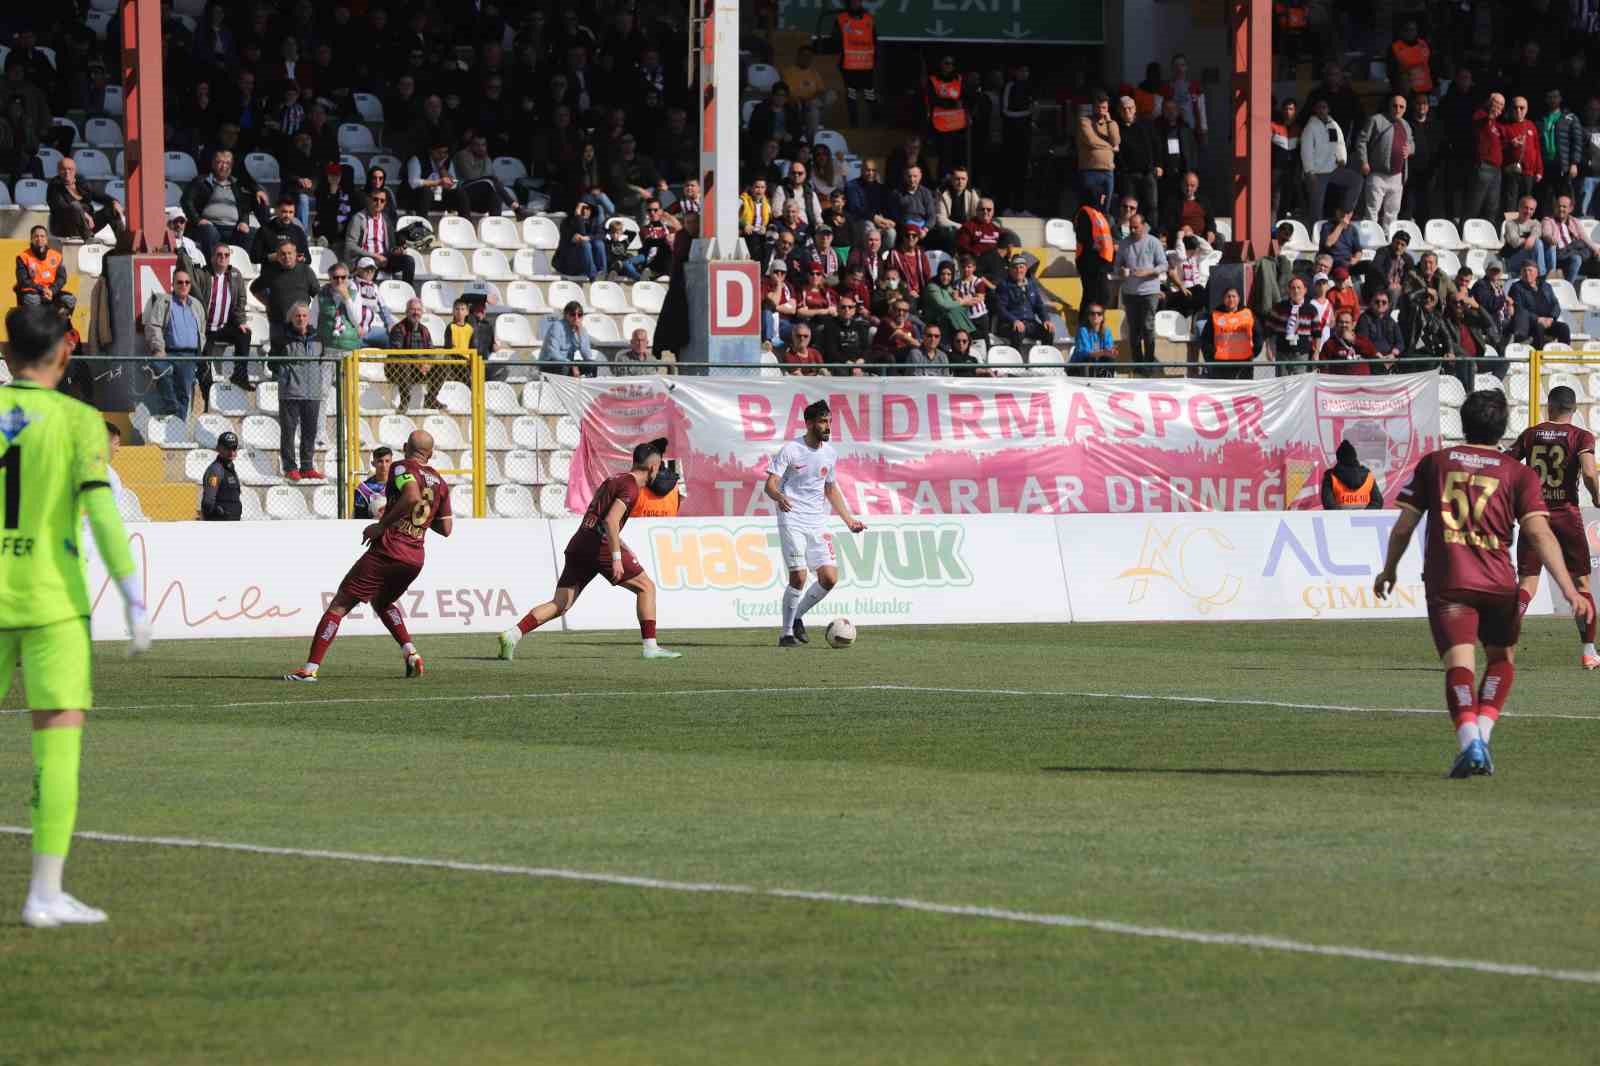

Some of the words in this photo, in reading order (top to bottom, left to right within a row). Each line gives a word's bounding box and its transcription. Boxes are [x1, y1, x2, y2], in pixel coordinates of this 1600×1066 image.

[716, 269, 754, 328] D
[736, 391, 1269, 442] BANDIRMASPOR
[1530, 445, 1566, 488] 53
[714, 476, 1087, 515] TAFTARLAR
[1104, 469, 1286, 513] DERNEĞ
[1441, 471, 1500, 531] 57
[1262, 515, 1426, 577] ALT
[436, 588, 518, 626] EŞYA
[1302, 579, 1424, 617] ÇİMN
